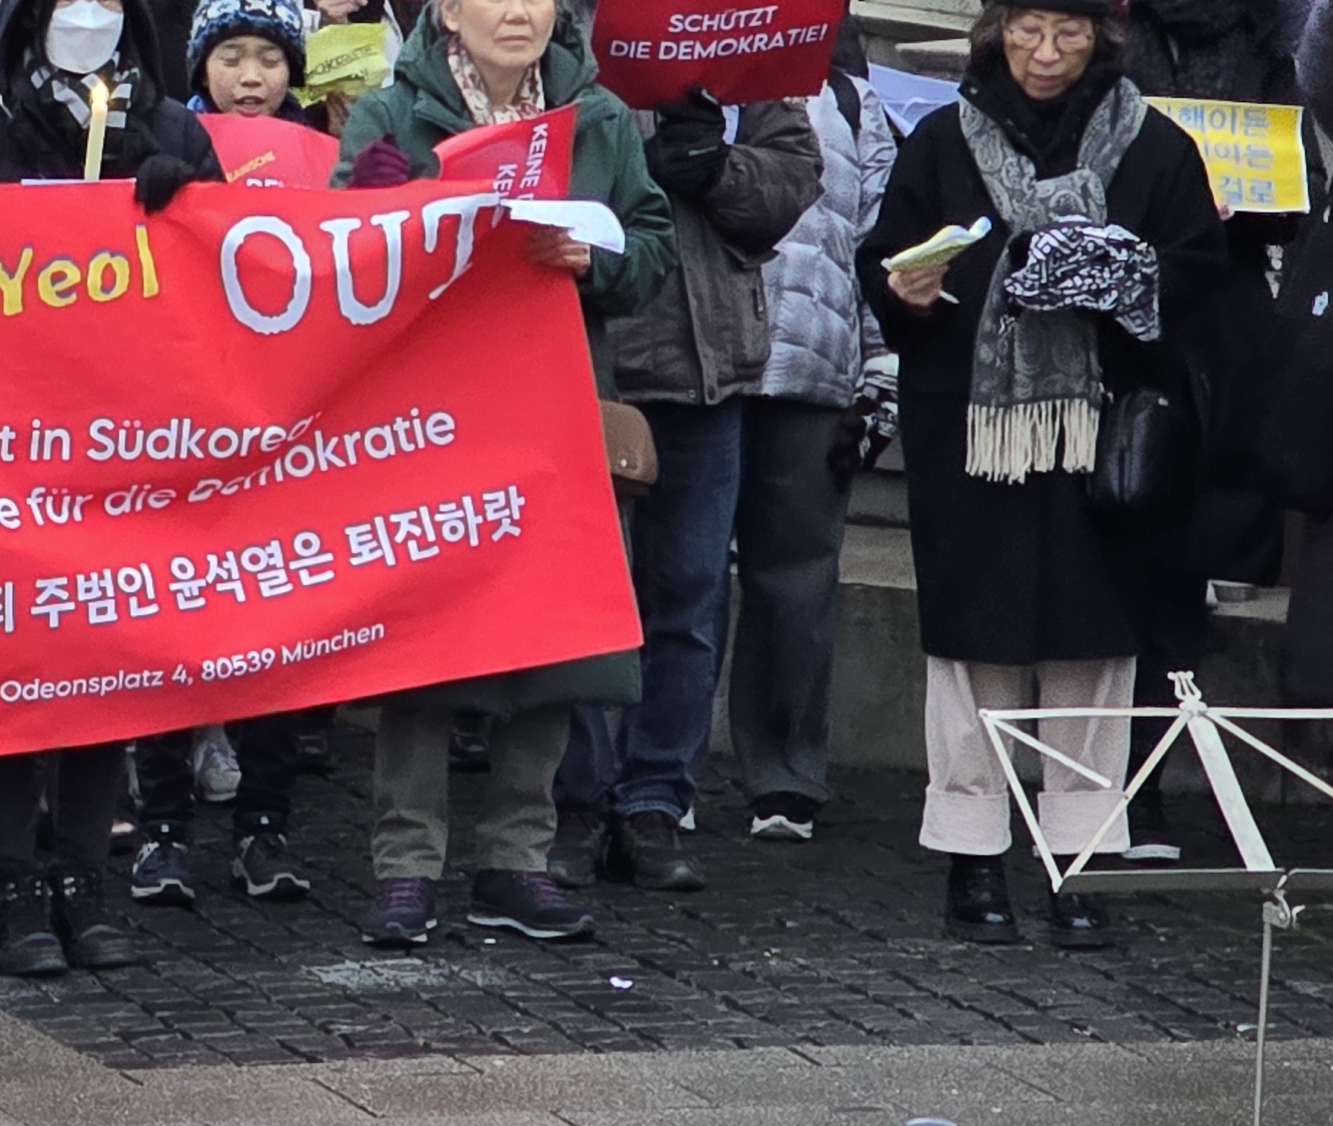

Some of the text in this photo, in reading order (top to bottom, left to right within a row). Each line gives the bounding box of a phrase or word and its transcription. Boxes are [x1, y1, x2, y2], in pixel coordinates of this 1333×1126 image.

[667, 5, 779, 33] SCHÜTZT
[609, 23, 829, 61] DIE DEMOKRATIE!
[220, 191, 503, 336] OUT
[28, 418, 72, 462] in
[25, 486, 95, 528] für
[103, 484, 178, 518] die
[30, 560, 161, 630] 주범인
[168, 529, 337, 613] 윤석열은
[343, 485, 527, 568] 퇴진하랏
[170, 663, 194, 686] 4,
[200, 647, 277, 682] 80539
[280, 621, 386, 665] München
